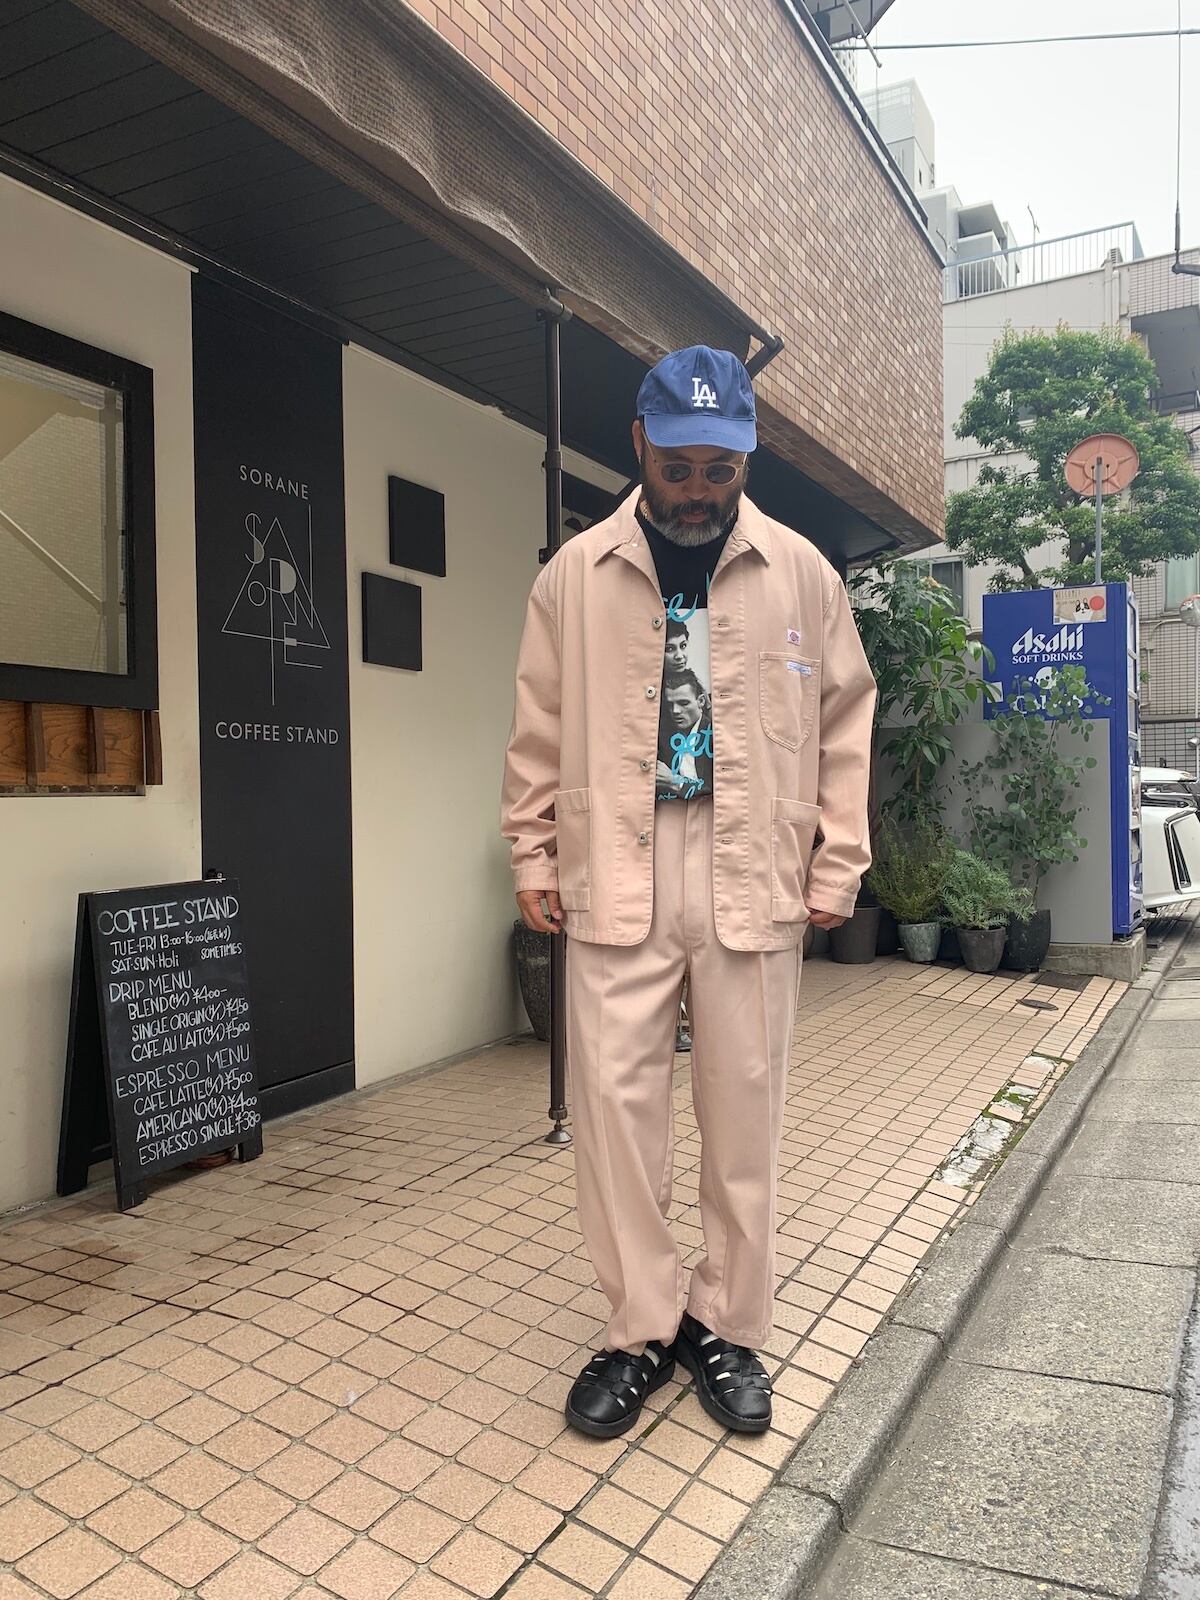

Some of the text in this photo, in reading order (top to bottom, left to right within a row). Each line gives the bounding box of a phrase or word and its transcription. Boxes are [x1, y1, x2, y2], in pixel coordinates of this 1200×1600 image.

[691, 377, 718, 408] LA
[239, 464, 309, 500] SORANE
[1012, 624, 1083, 655] Asahi
[1012, 651, 1084, 665] SOFT DRINKS
[215, 721, 339, 745] COFFEE STAND
[98, 895, 239, 935] COFFEE STAND
[201, 943, 243, 960] SOMETIMES
[109, 970, 192, 1003] DRIP MENU
[131, 1016, 169, 1042] SINGLE
[131, 1038, 161, 1063] CAFE
[162, 1035, 178, 1056] AU
[115, 1044, 250, 1099] ESPRESSO MENU
[134, 1090, 168, 1116] CAFE
[138, 1128, 198, 1166] ESPRESSO
[200, 1116, 235, 1144] SINGLE
